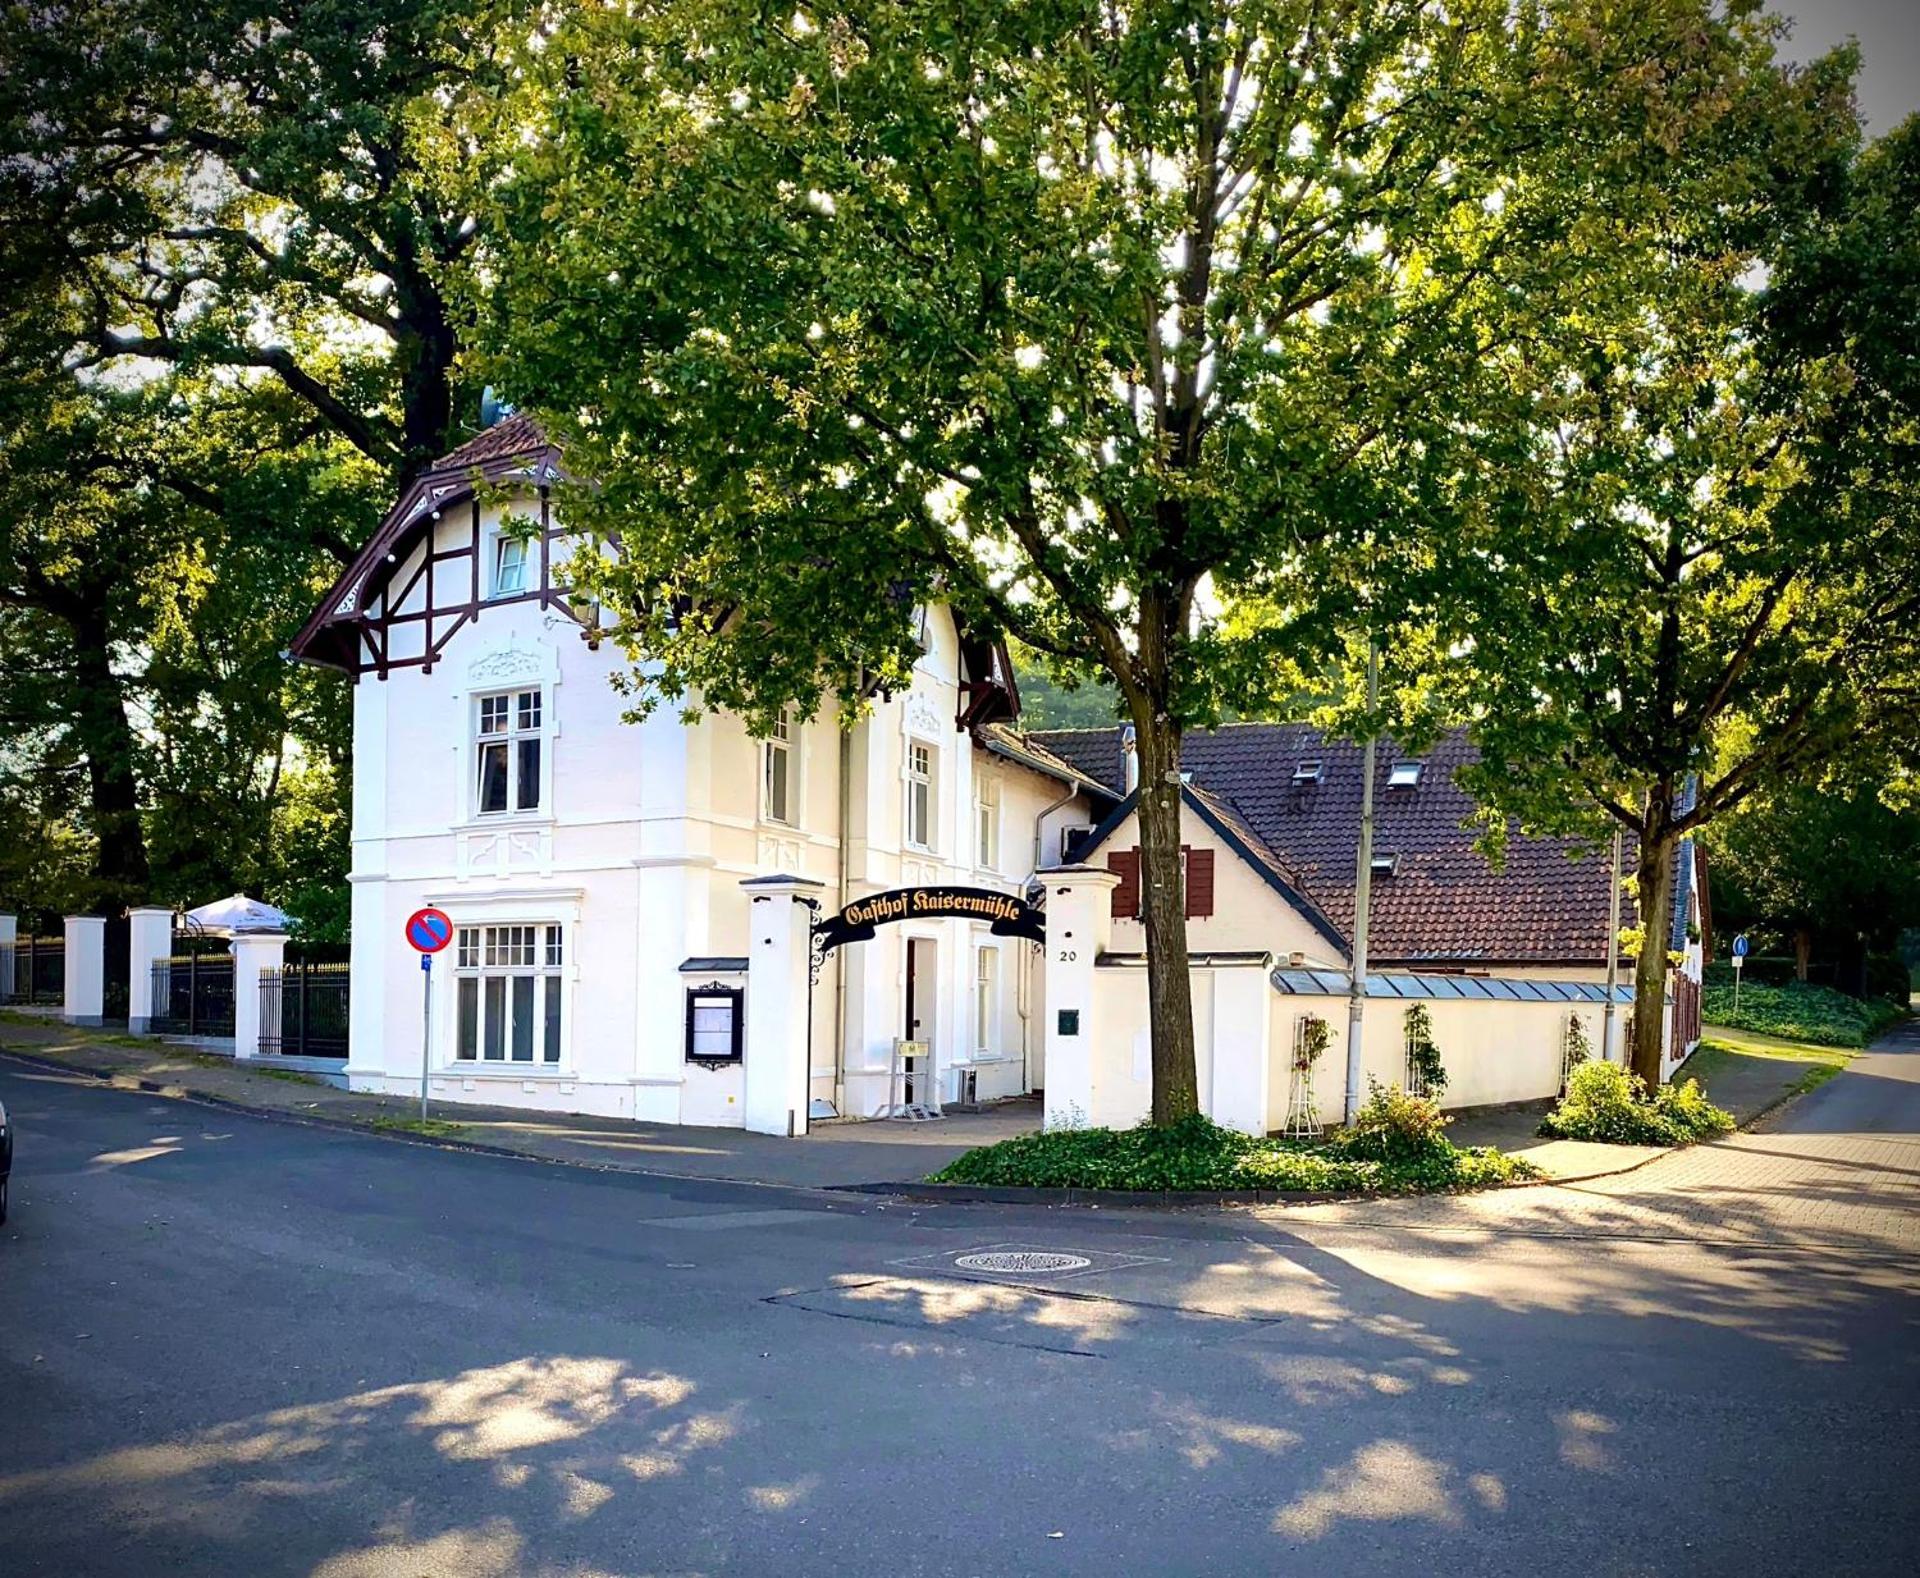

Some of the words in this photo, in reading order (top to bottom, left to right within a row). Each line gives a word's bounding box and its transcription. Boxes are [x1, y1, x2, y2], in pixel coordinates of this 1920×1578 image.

[845, 892, 908, 925] Gasthof
[913, 890, 1020, 920] Kaisermühle
[1059, 951, 1077, 962] 20
